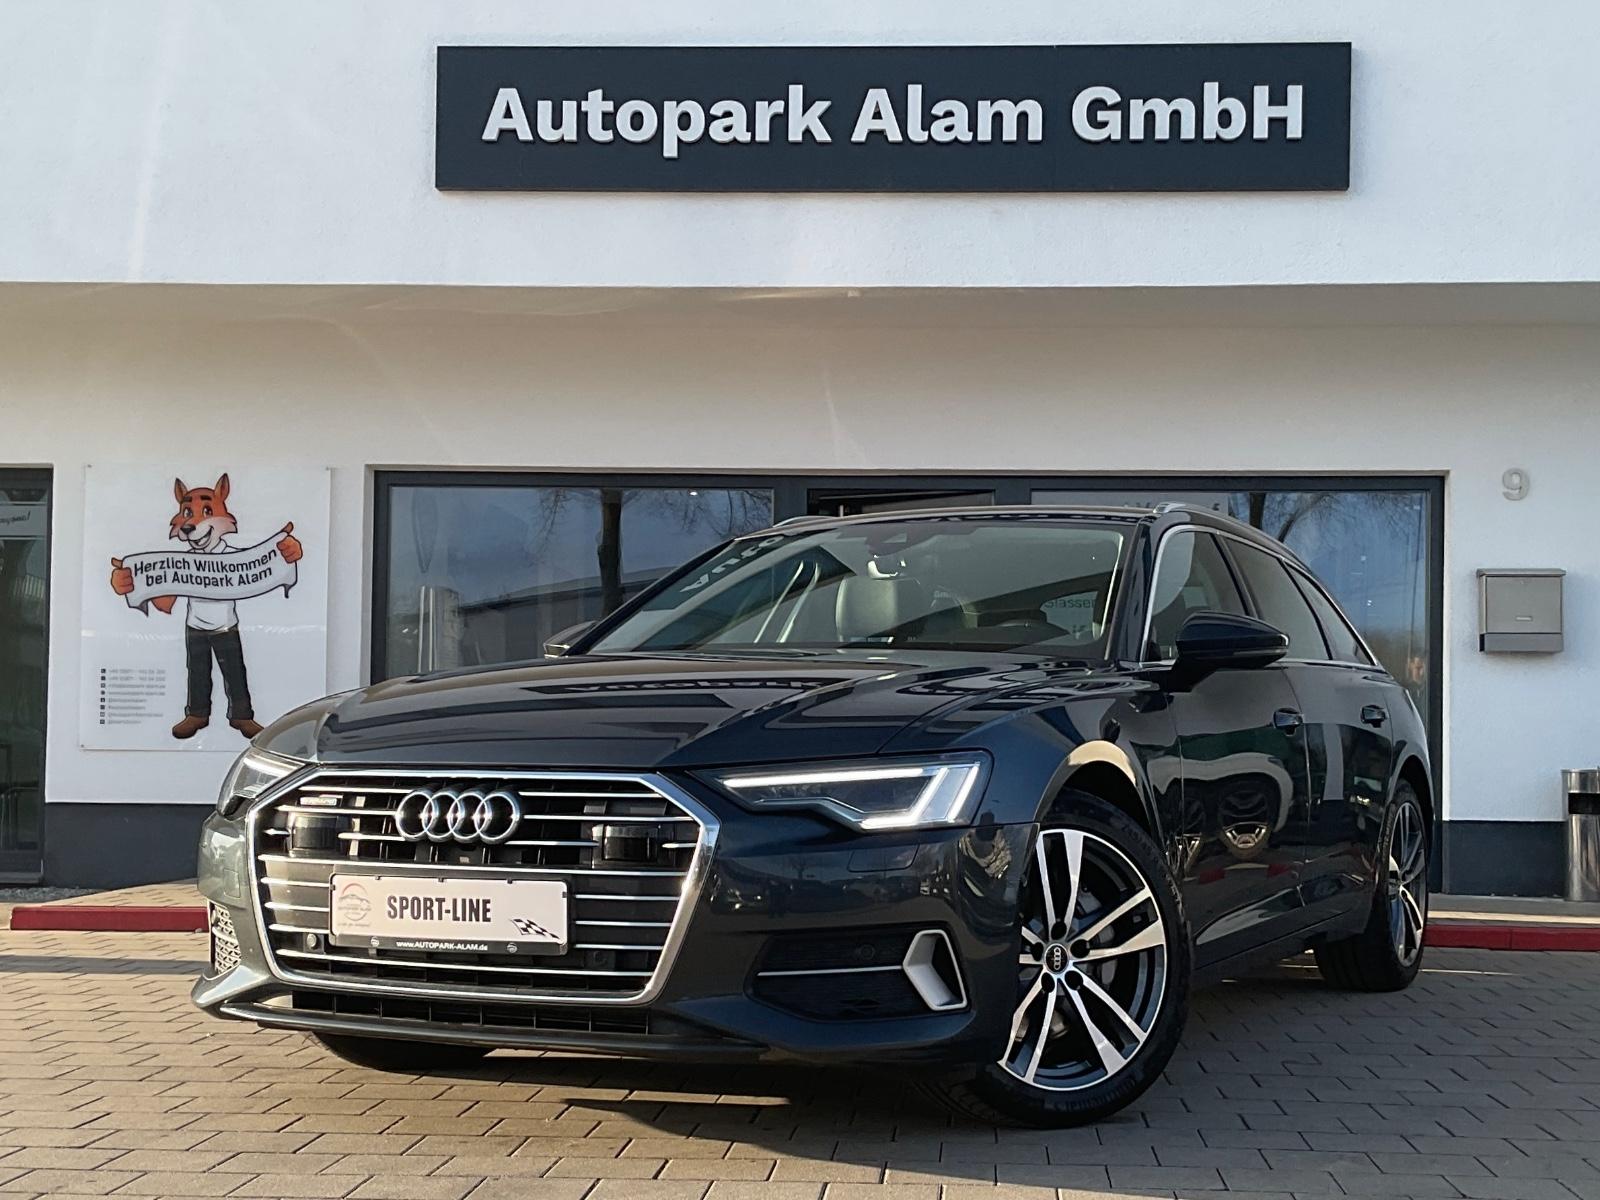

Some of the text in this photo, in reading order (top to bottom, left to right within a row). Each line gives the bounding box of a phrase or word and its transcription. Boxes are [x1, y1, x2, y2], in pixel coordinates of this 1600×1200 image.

[482, 81, 1305, 159] Autopark Alam GmbH
[1502, 468, 1530, 500] 9
[134, 549, 278, 577] Herzlich Willkommen
[146, 567, 273, 588] bei Autopark Alam
[387, 895, 492, 922] SPORT-LINE
[396, 940, 488, 951] www.AUTOPARK-ALAM.de
